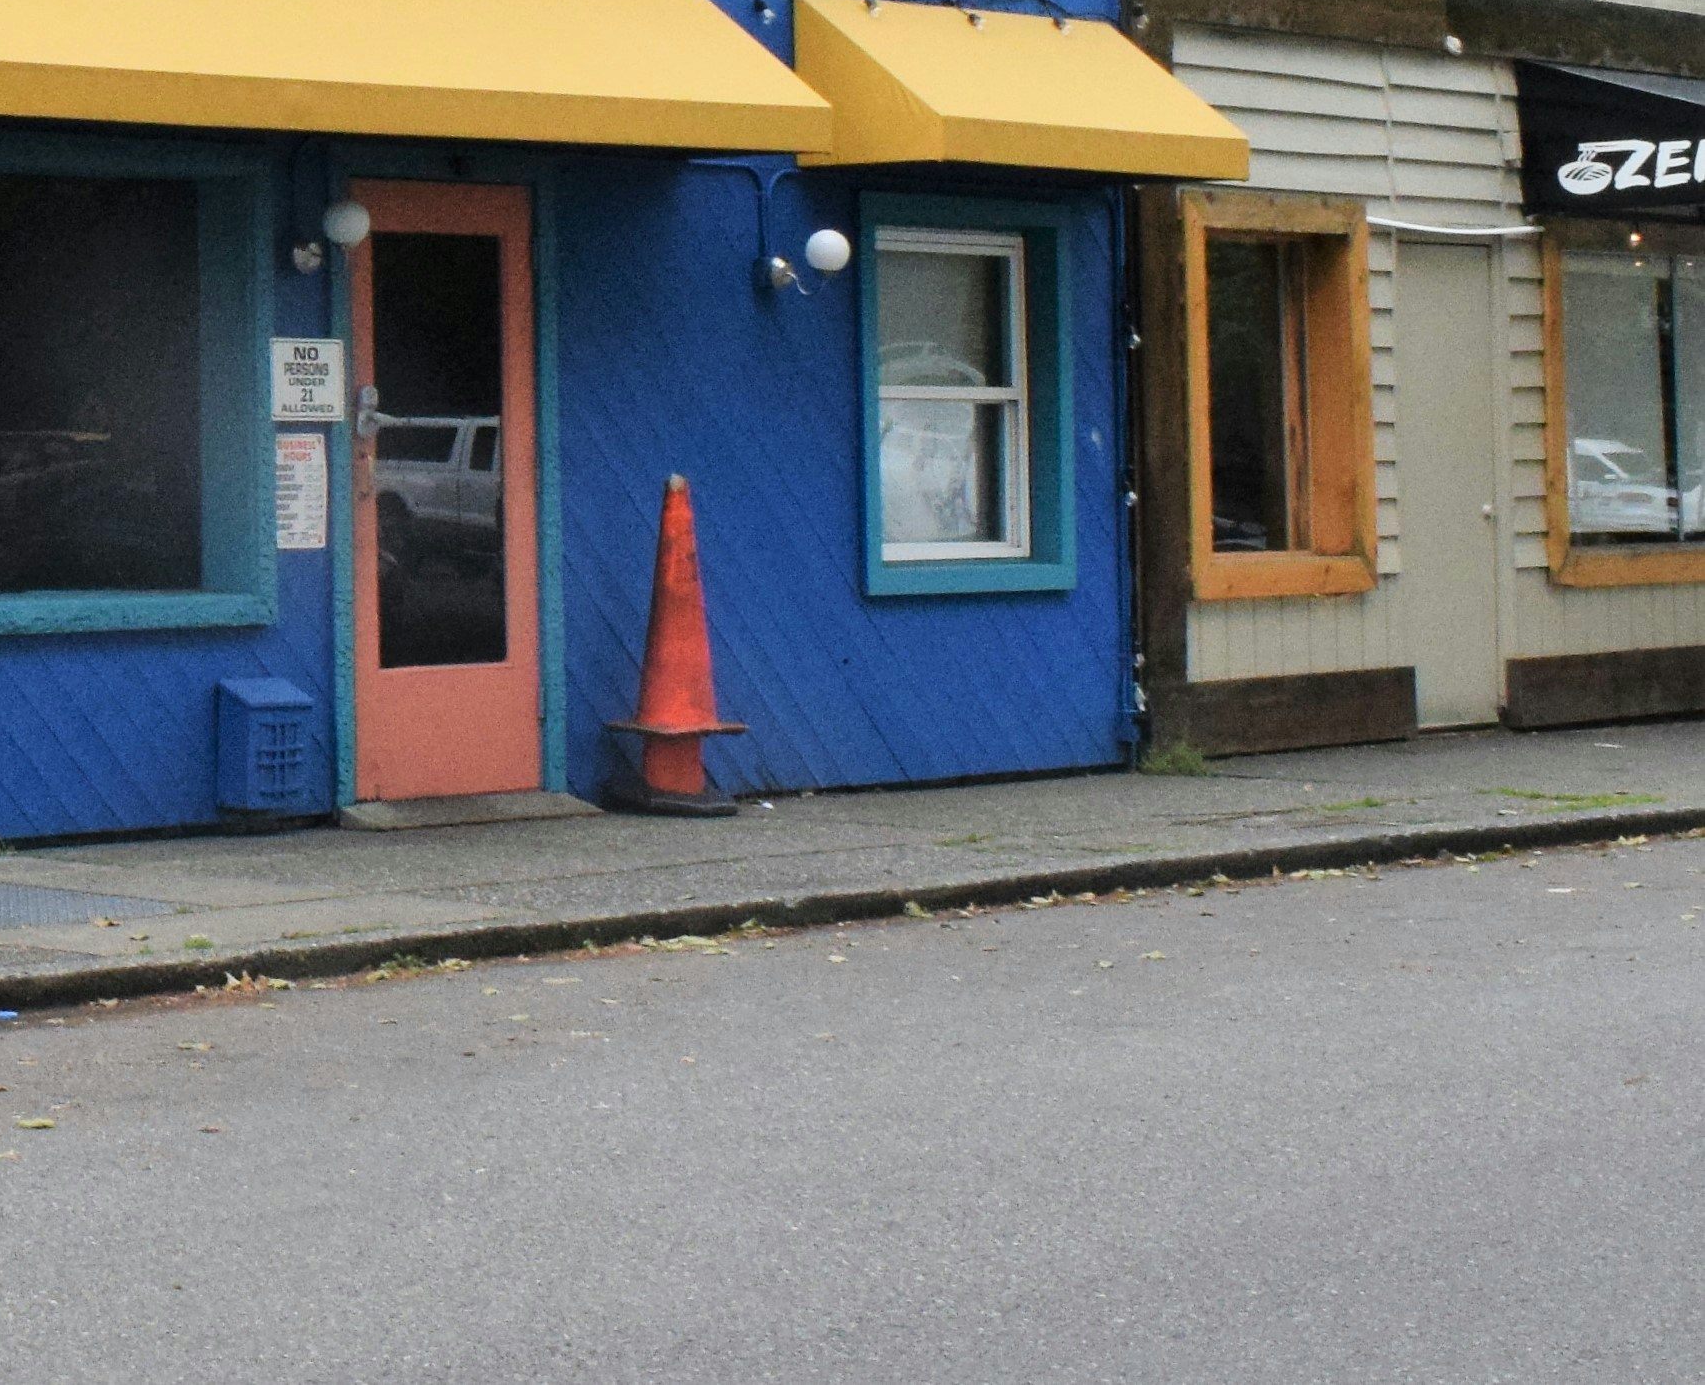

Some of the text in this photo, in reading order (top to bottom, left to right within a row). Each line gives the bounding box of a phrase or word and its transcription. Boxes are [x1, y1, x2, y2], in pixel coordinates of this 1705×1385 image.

[293, 346, 319, 361] NO
[283, 362, 329, 376] PERSONS
[288, 377, 326, 386] UNDER
[300, 388, 314, 403] 21
[281, 403, 334, 413] ALLOWED
